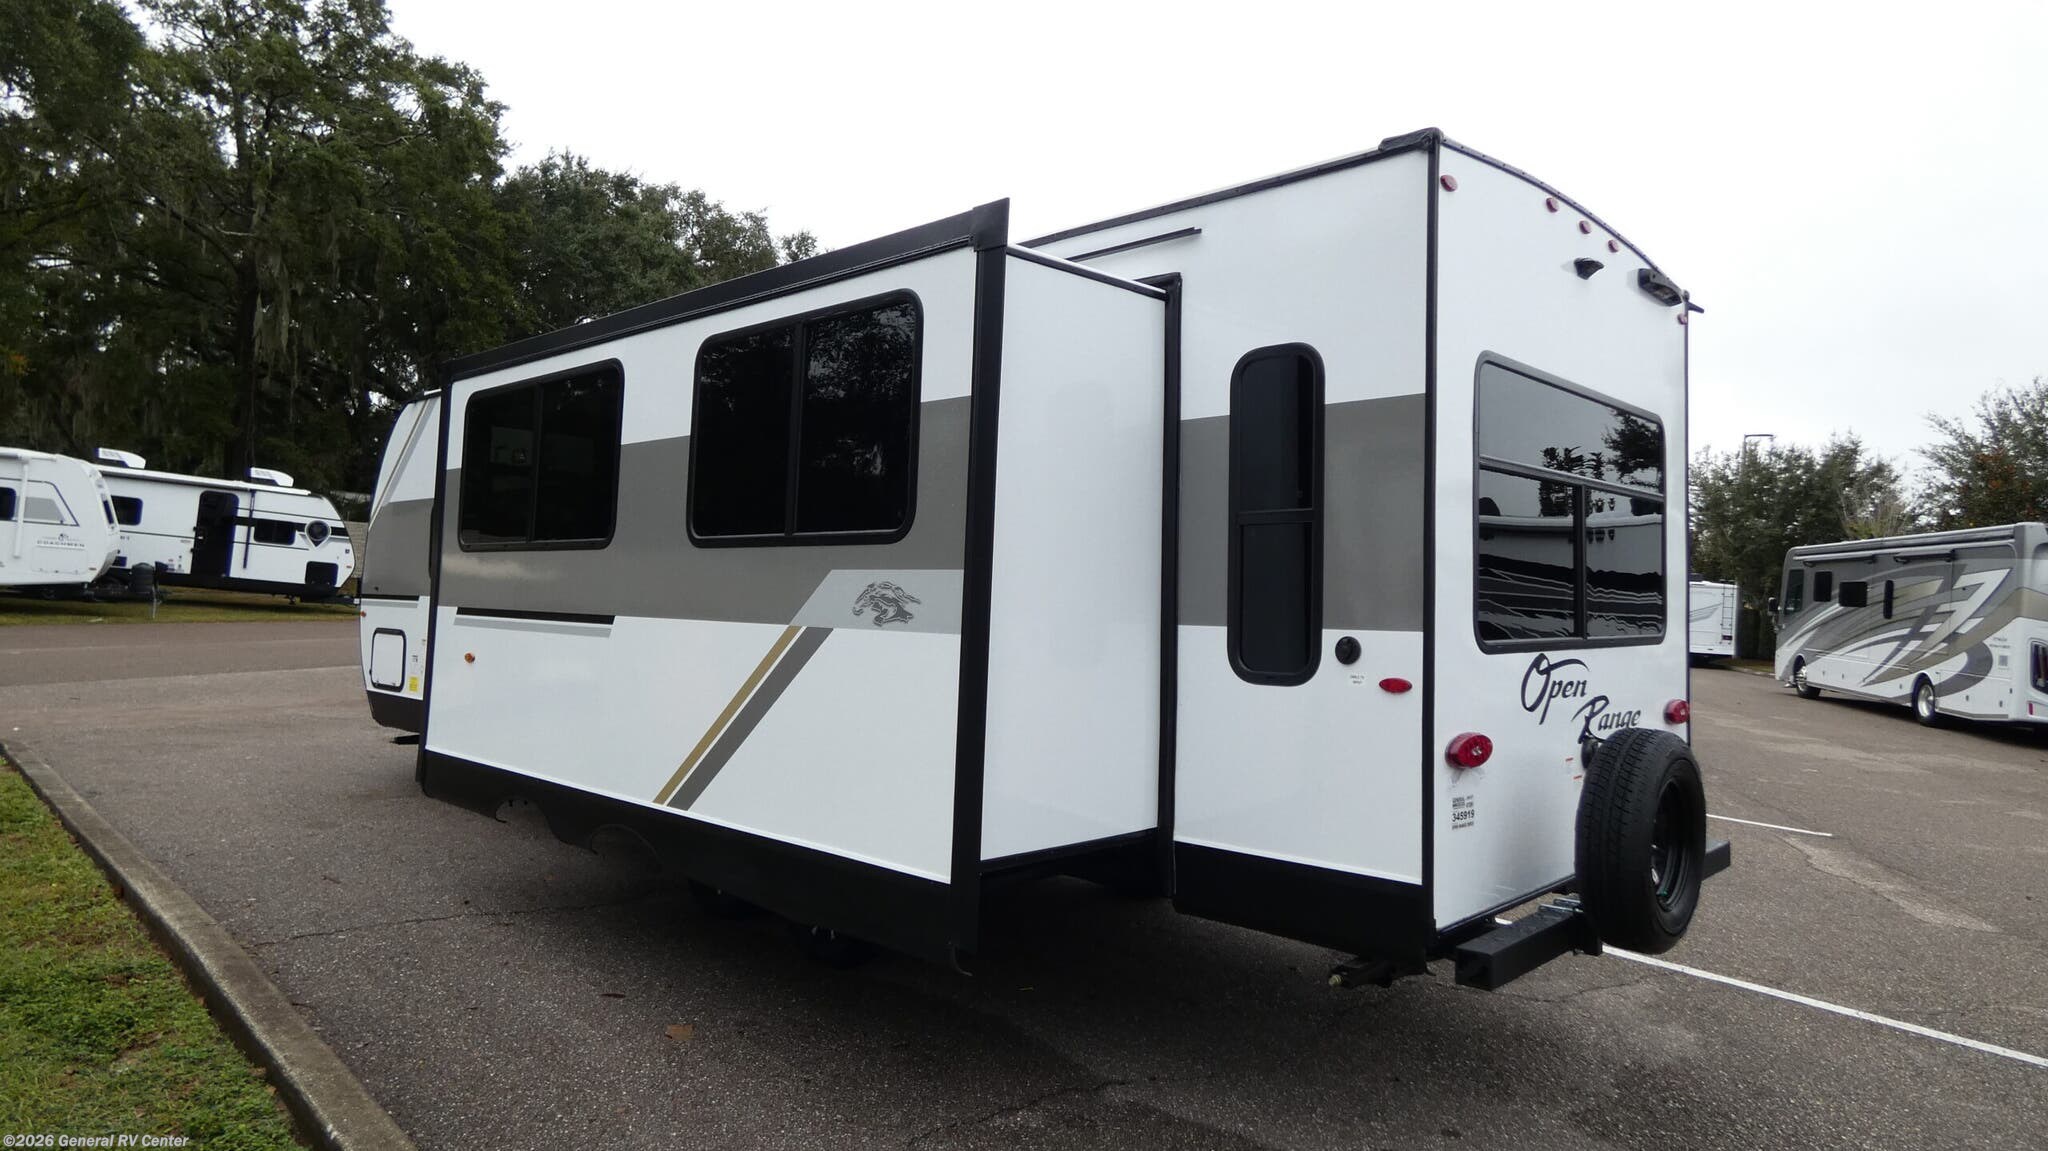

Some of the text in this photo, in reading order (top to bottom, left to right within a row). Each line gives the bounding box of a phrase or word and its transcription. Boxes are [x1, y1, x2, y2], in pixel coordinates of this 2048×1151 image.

[1520, 652, 1590, 725] Open
[1570, 695, 1642, 744] Range
[1451, 809, 1475, 823] 345919
